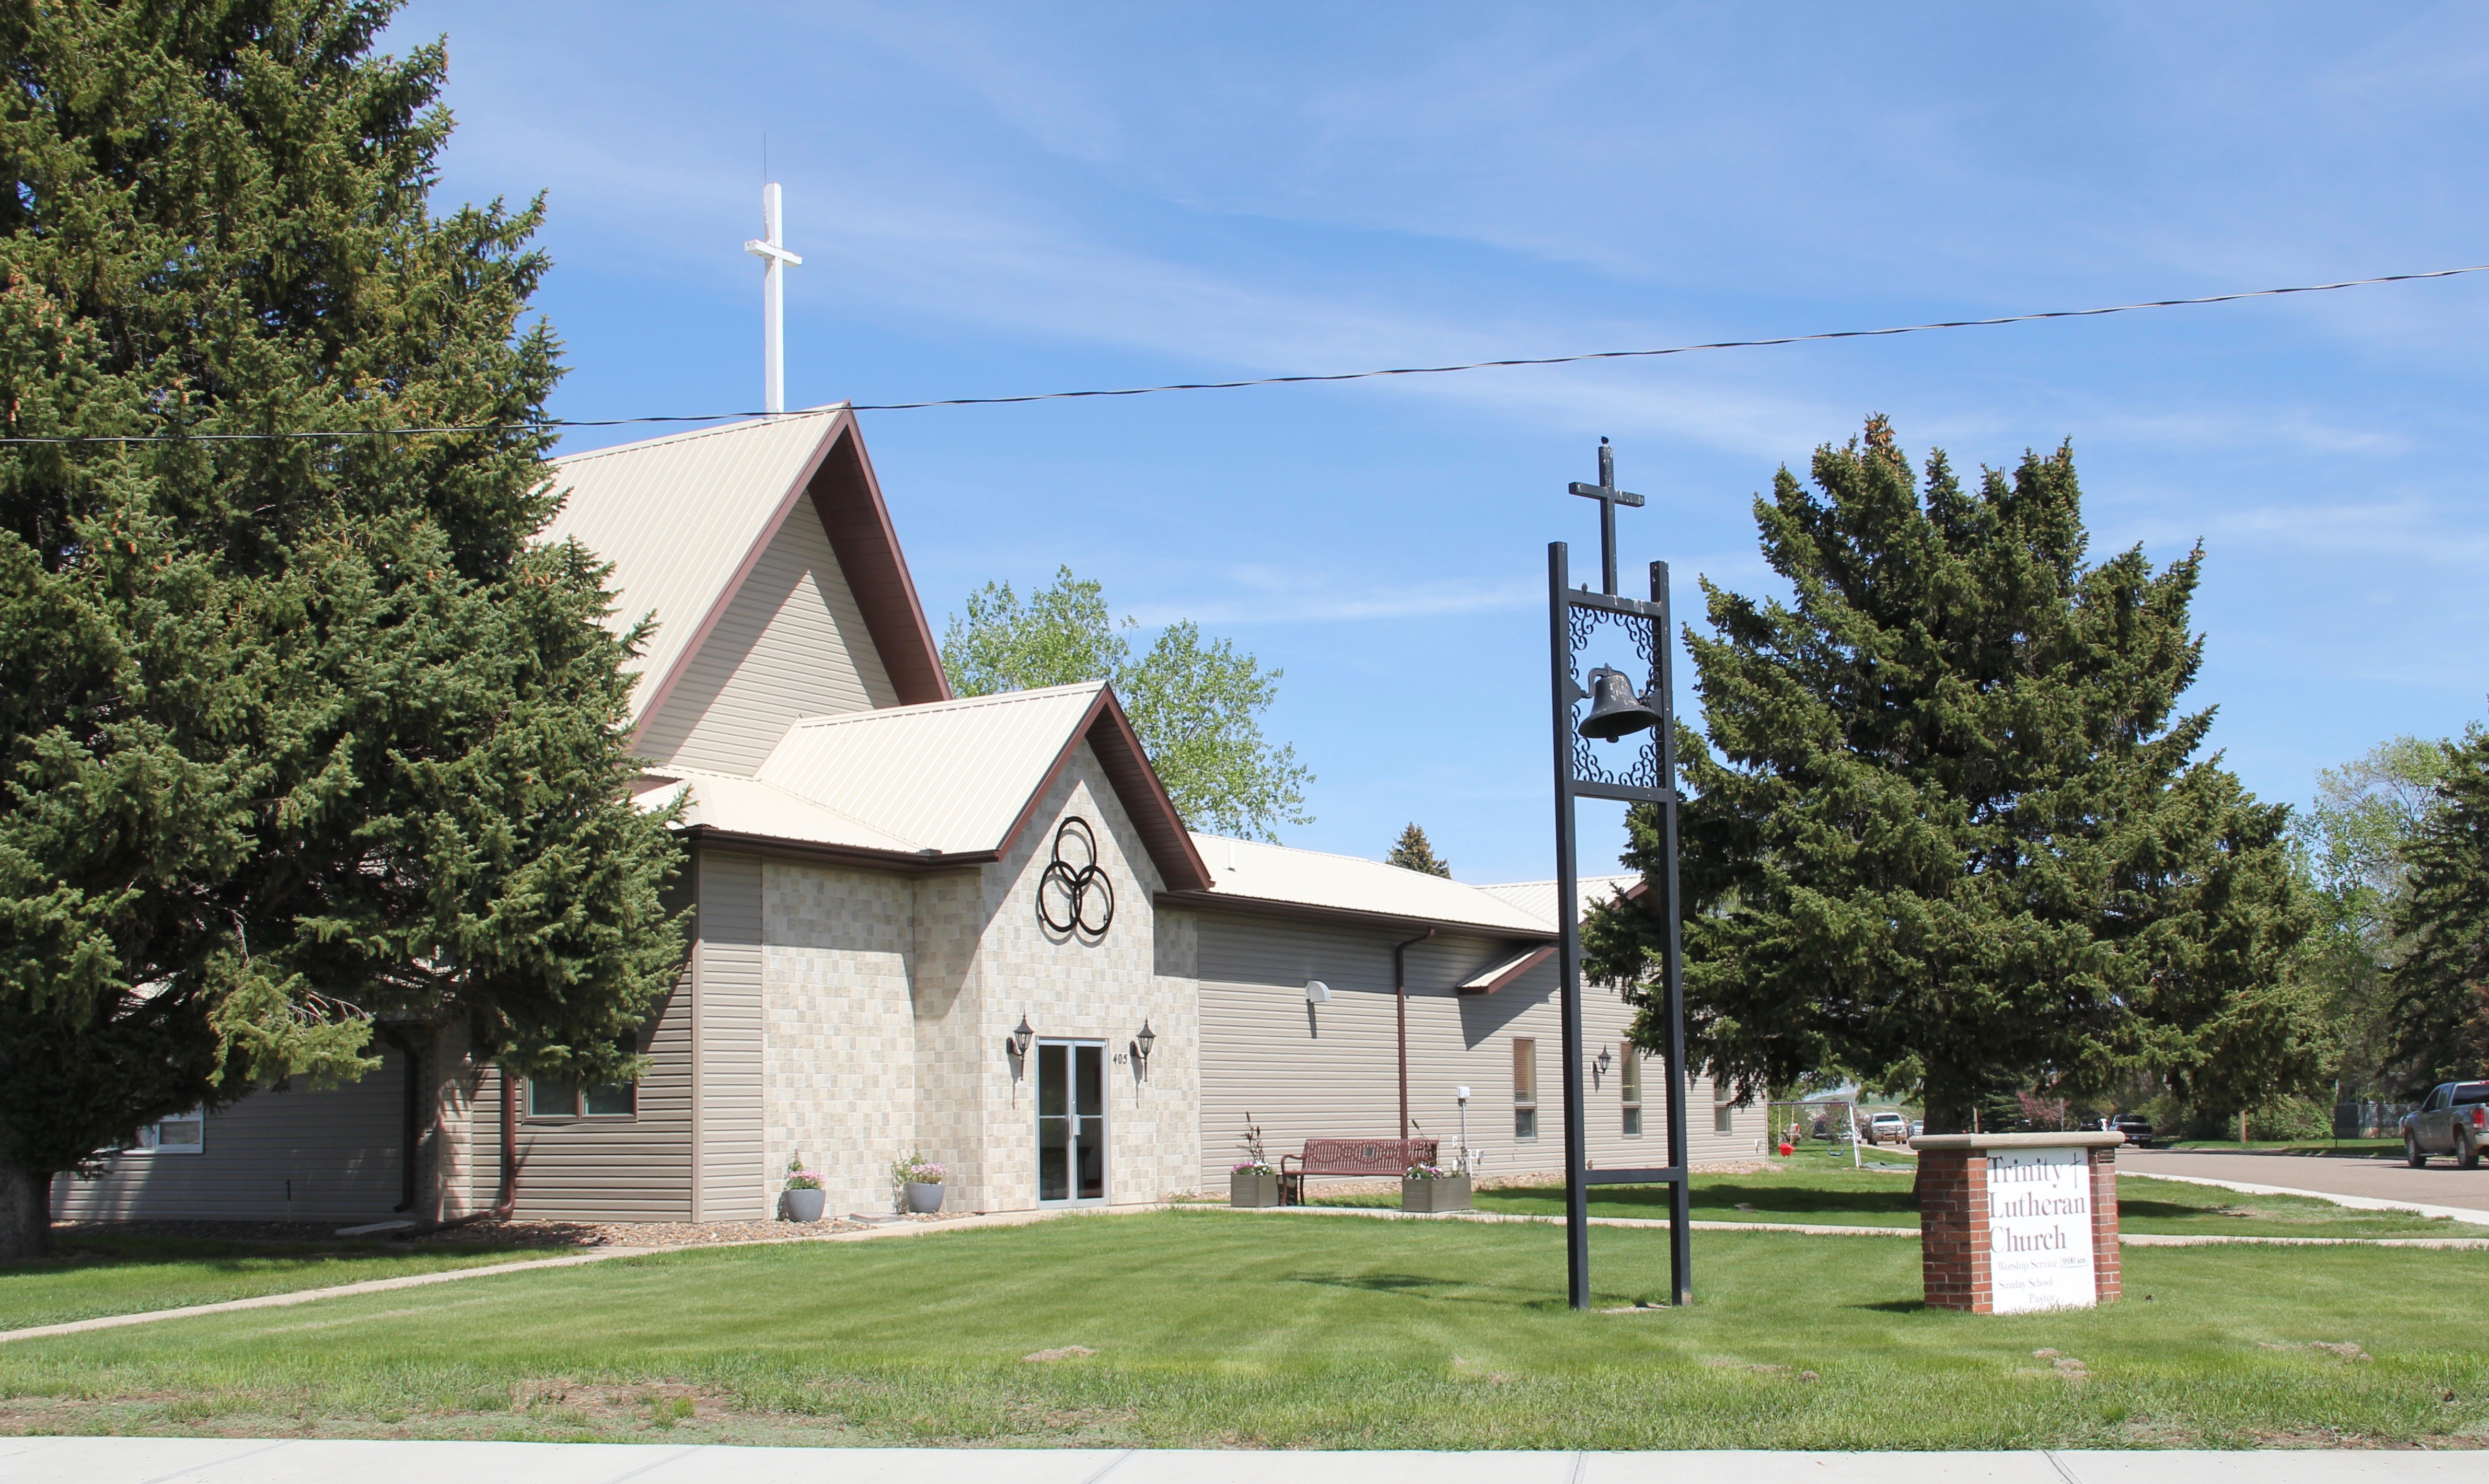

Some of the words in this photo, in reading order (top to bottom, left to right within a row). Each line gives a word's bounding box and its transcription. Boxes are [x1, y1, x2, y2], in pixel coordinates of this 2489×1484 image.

[1113, 1052, 1128, 1065] 405
[1987, 1156, 2062, 1188] Trinity
[1987, 1191, 2087, 1219] Lutheran
[1990, 1224, 2067, 1253] Church
[1997, 1260, 2029, 1272] Worship
[2031, 1259, 2057, 1269] Service
[2062, 1256, 2076, 1265] 9:00
[1998, 1279, 2027, 1291] Sunday
[2028, 1277, 2053, 1288] School
[2029, 1293, 2055, 1304] Pastor
